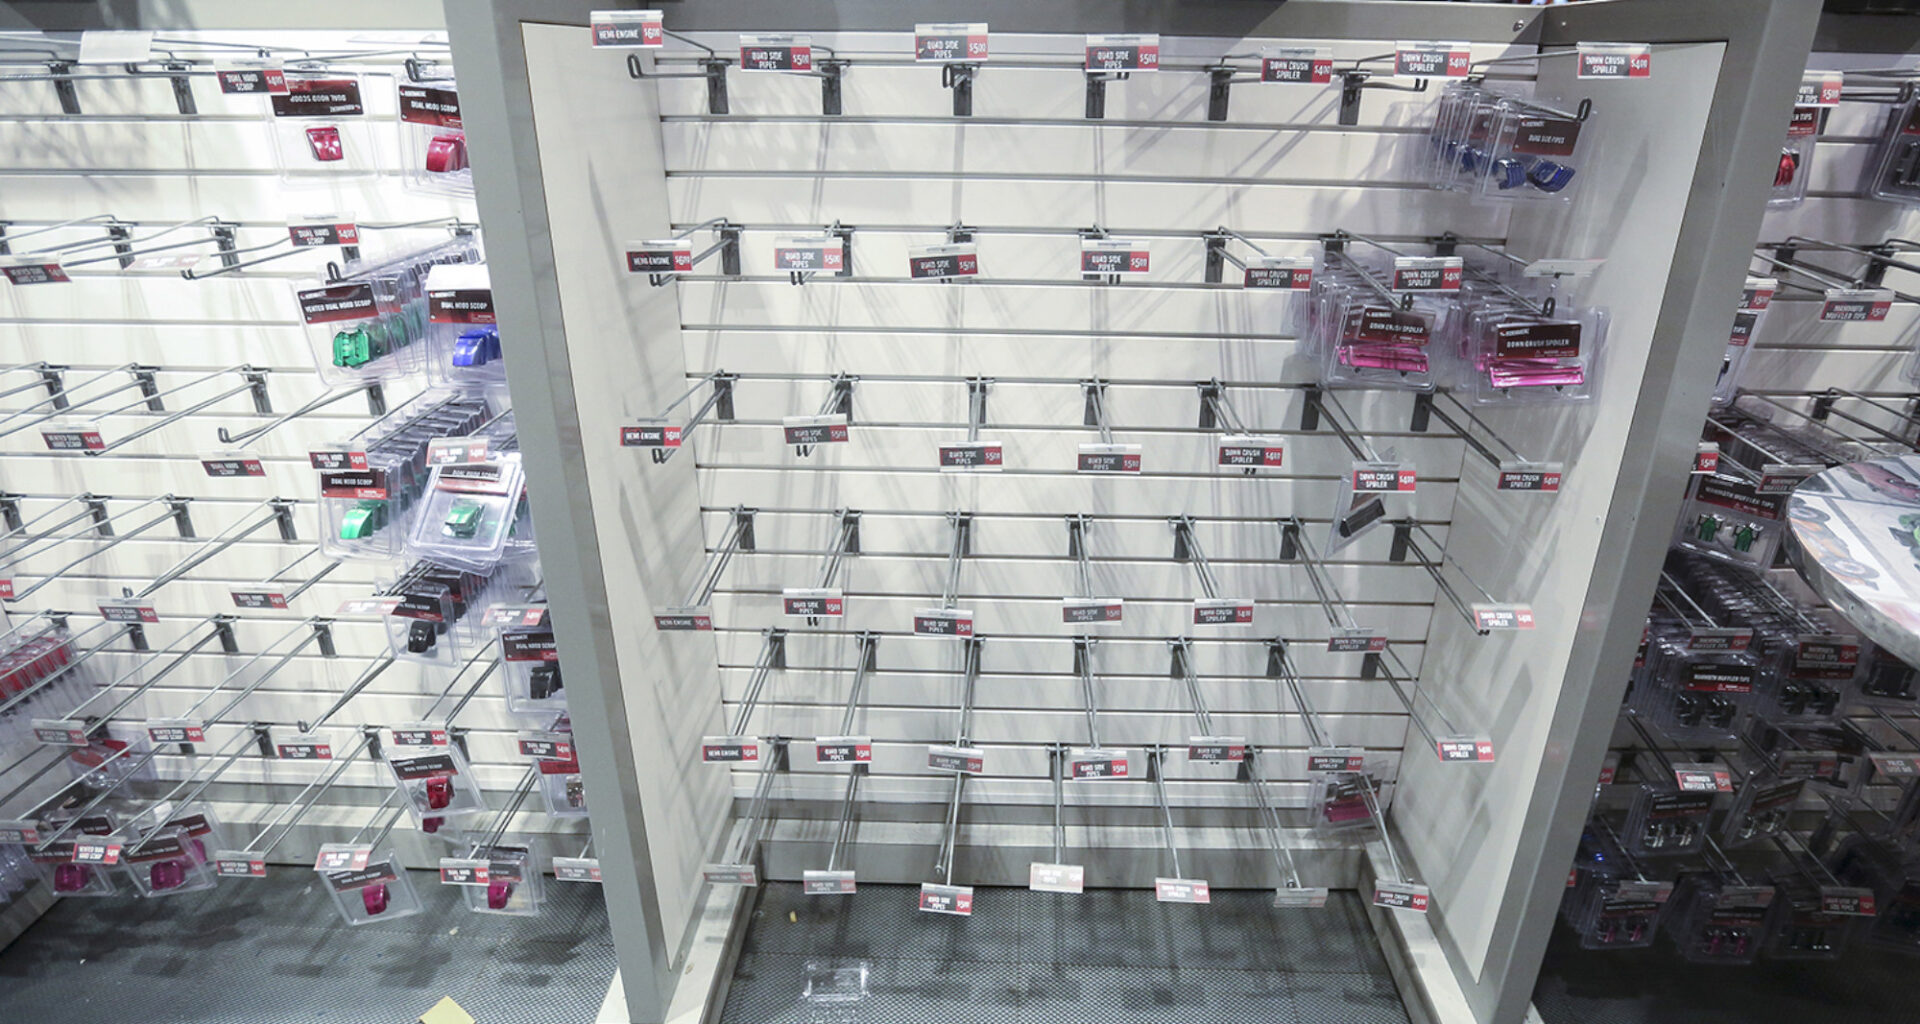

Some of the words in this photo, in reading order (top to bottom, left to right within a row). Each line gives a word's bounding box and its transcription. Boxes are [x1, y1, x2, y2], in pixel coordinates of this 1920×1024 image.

[927, 41, 944, 49] QUAD
[945, 40, 959, 49] SIDE
[751, 52, 768, 60] QUAD
[770, 52, 783, 60] SIDE
[935, 50, 952, 58] PIPES
[1097, 52, 1114, 60] QUAD
[1115, 51, 1128, 60] SIDE
[1402, 54, 1421, 62] DOWN
[1422, 54, 1443, 63] CRUSH
[1586, 56, 1603, 65] DOWN
[1605, 56, 1625, 65] CRUSH
[1105, 61, 1122, 69] PIPES
[1270, 61, 1288, 70] DOWN
[1290, 61, 1308, 70] CRUSH
[1409, 63, 1434, 71] SPOILER
[1592, 65, 1617, 73] SPOILER
[1276, 70, 1301, 79] SPOILER
[1251, 270, 1267, 278] DOWN
[1269, 270, 1288, 278] CRUSH
[1402, 271, 1419, 279] DOWN
[1420, 271, 1439, 279] CRUSH
[1408, 279, 1431, 287] SPOILER
[1738, 300, 1748, 308] IPS
[1506, 340, 1524, 348] DOWN
[1525, 340, 1544, 348] CRUSH
[1545, 338, 1570, 346] SPOILER
[1359, 473, 1374, 481] DOWN
[1376, 473, 1394, 481] CRUSH
[1366, 480, 1387, 488] SPOILER
